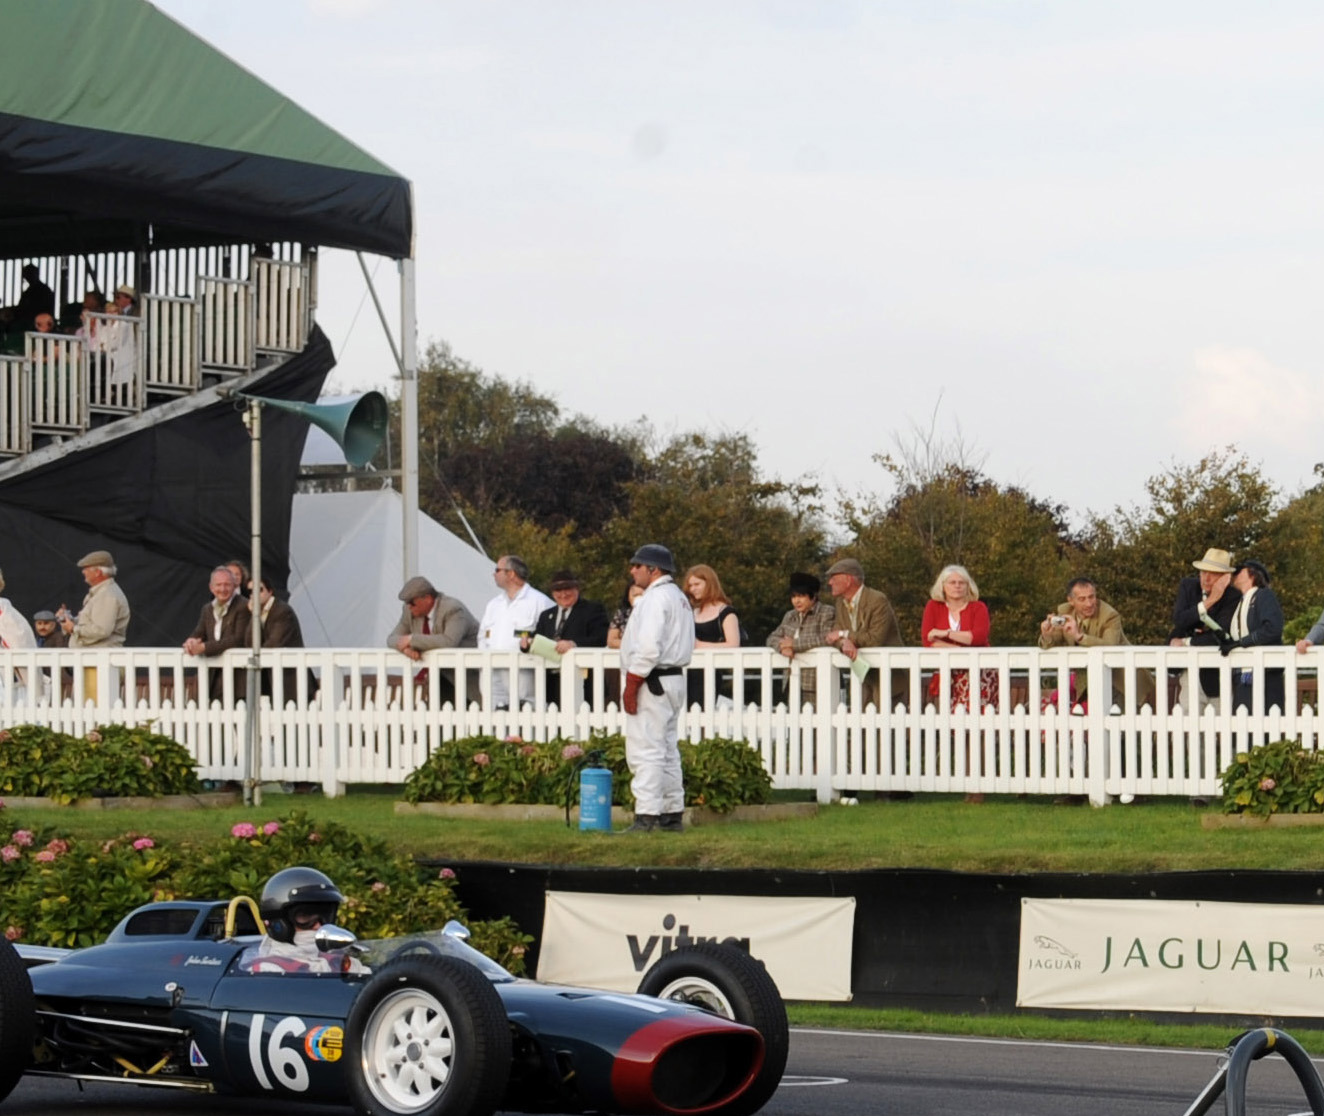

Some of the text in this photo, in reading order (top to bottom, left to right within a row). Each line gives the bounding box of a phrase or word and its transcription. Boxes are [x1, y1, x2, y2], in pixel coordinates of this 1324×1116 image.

[626, 913, 750, 972] vit
[1028, 958, 1082, 970] JAGUAR
[1101, 936, 1291, 973] JAGUAR
[248, 1013, 310, 1092] 16
